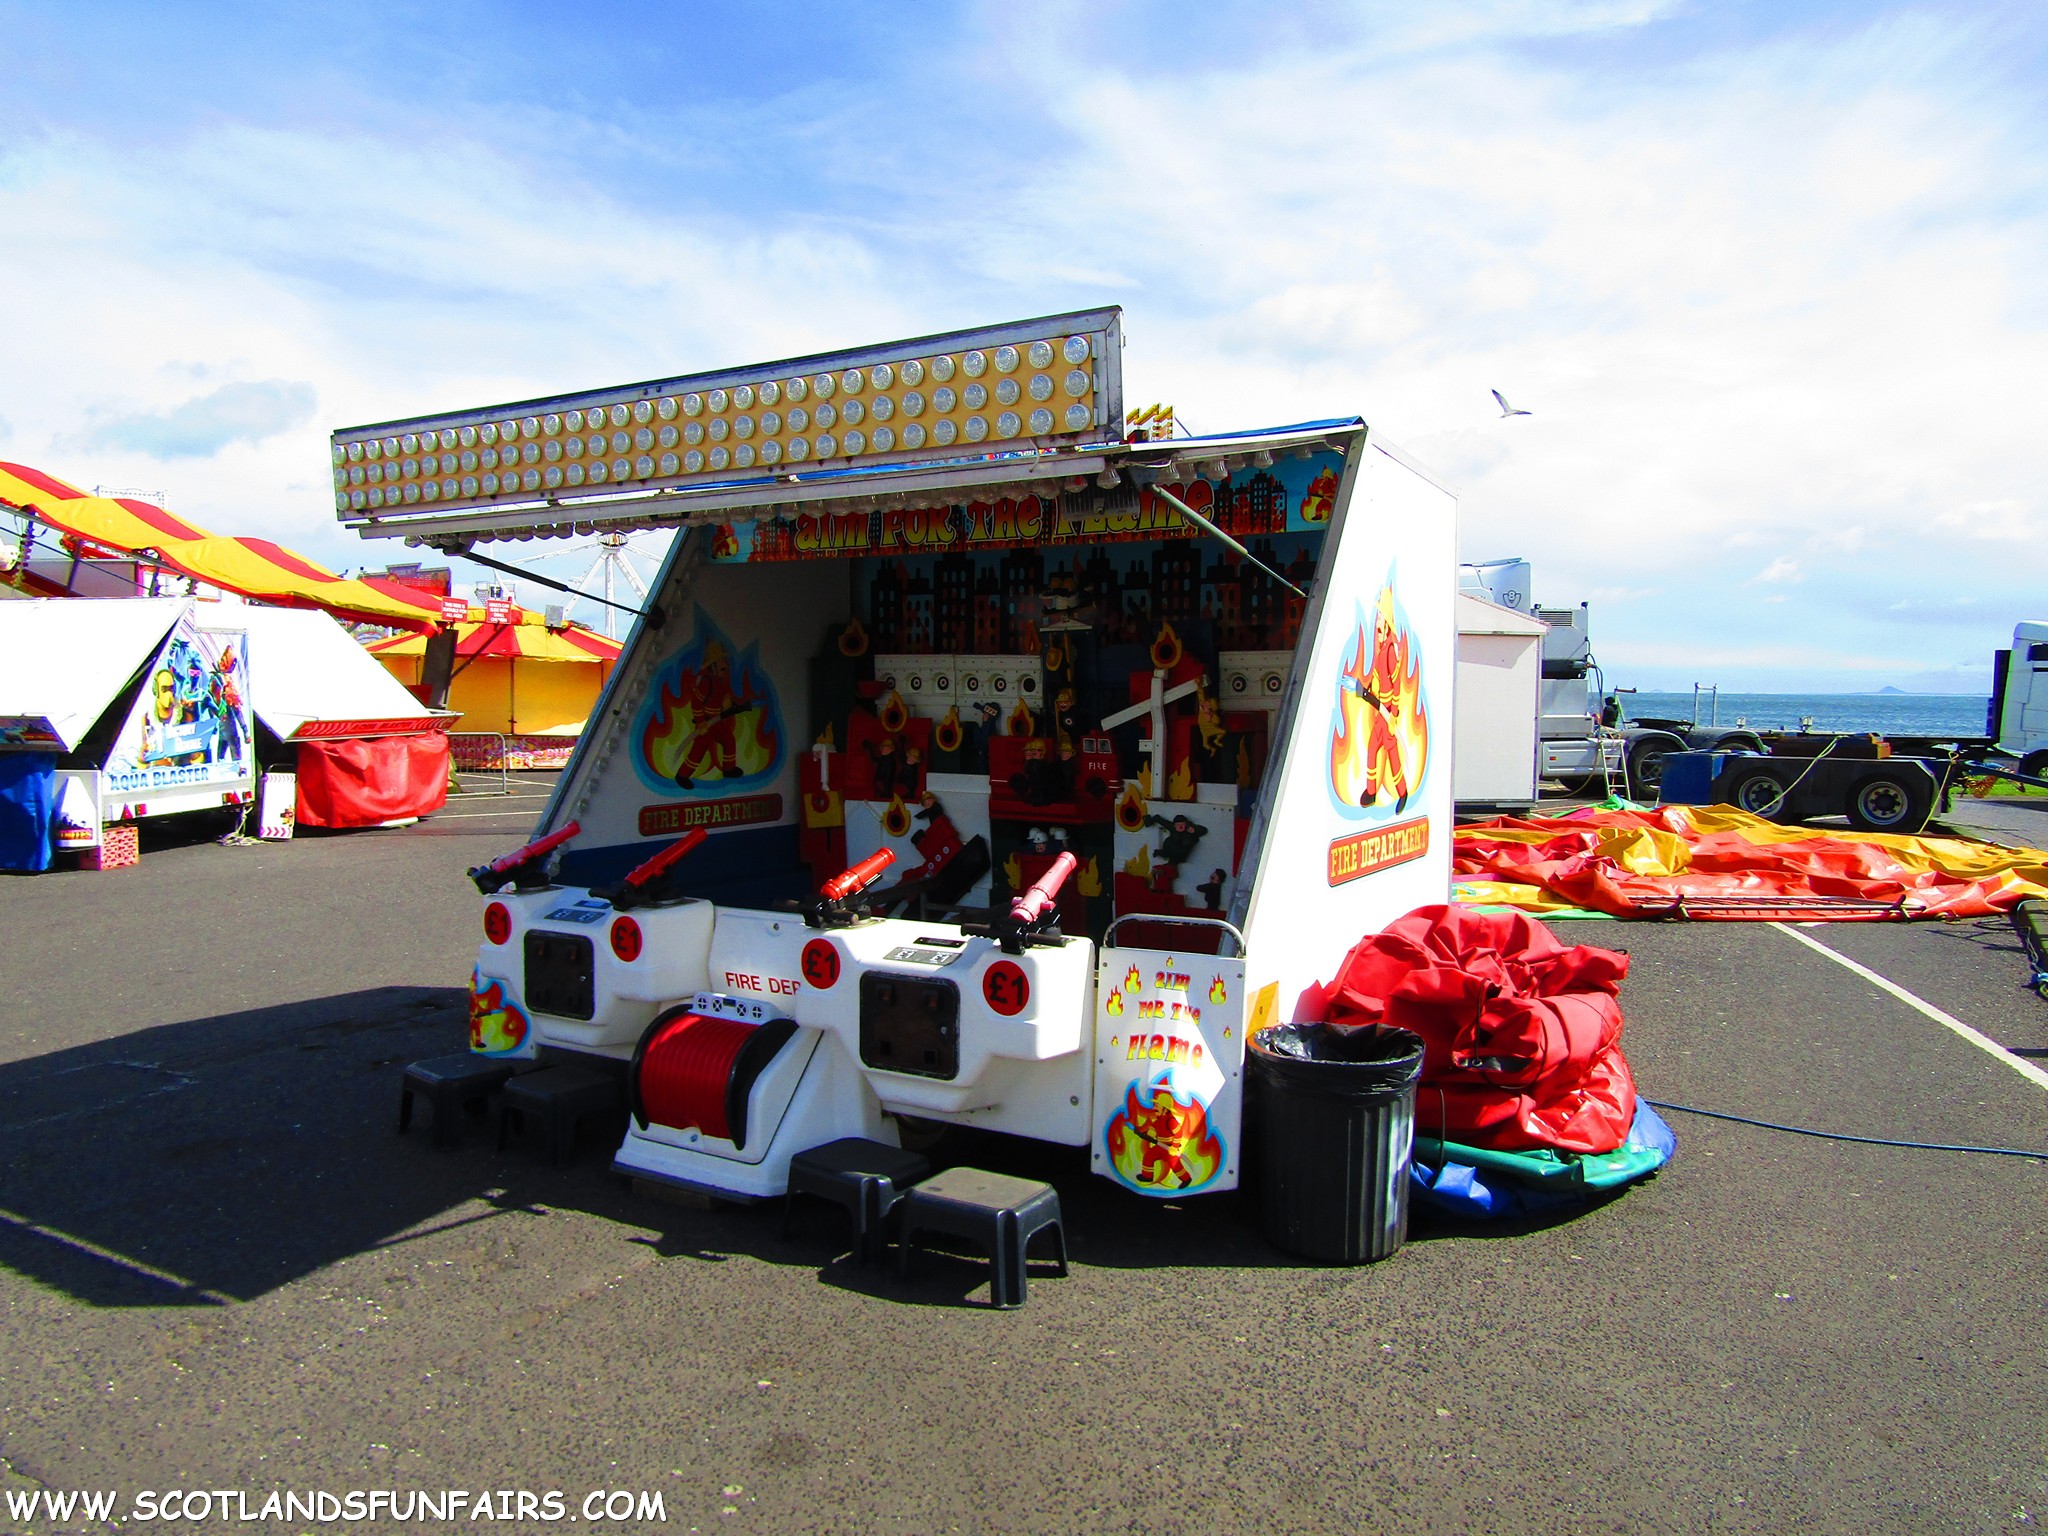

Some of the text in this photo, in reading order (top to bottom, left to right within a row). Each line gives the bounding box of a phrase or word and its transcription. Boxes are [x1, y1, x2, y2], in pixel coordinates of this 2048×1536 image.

[109, 766, 210, 791] AQUA BLASTER
[1089, 762, 1107, 770] FIRE
[644, 798, 778, 830] FIRE DEPARTMENT
[1330, 824, 1427, 879] FIRE DEPARTMENT
[489, 910, 509, 935] £1
[614, 924, 639, 953] £1
[806, 948, 835, 979] £1
[725, 972, 762, 991] FIRE
[990, 971, 1025, 1006] £1
[1137, 1000, 1165, 1019] FOR
